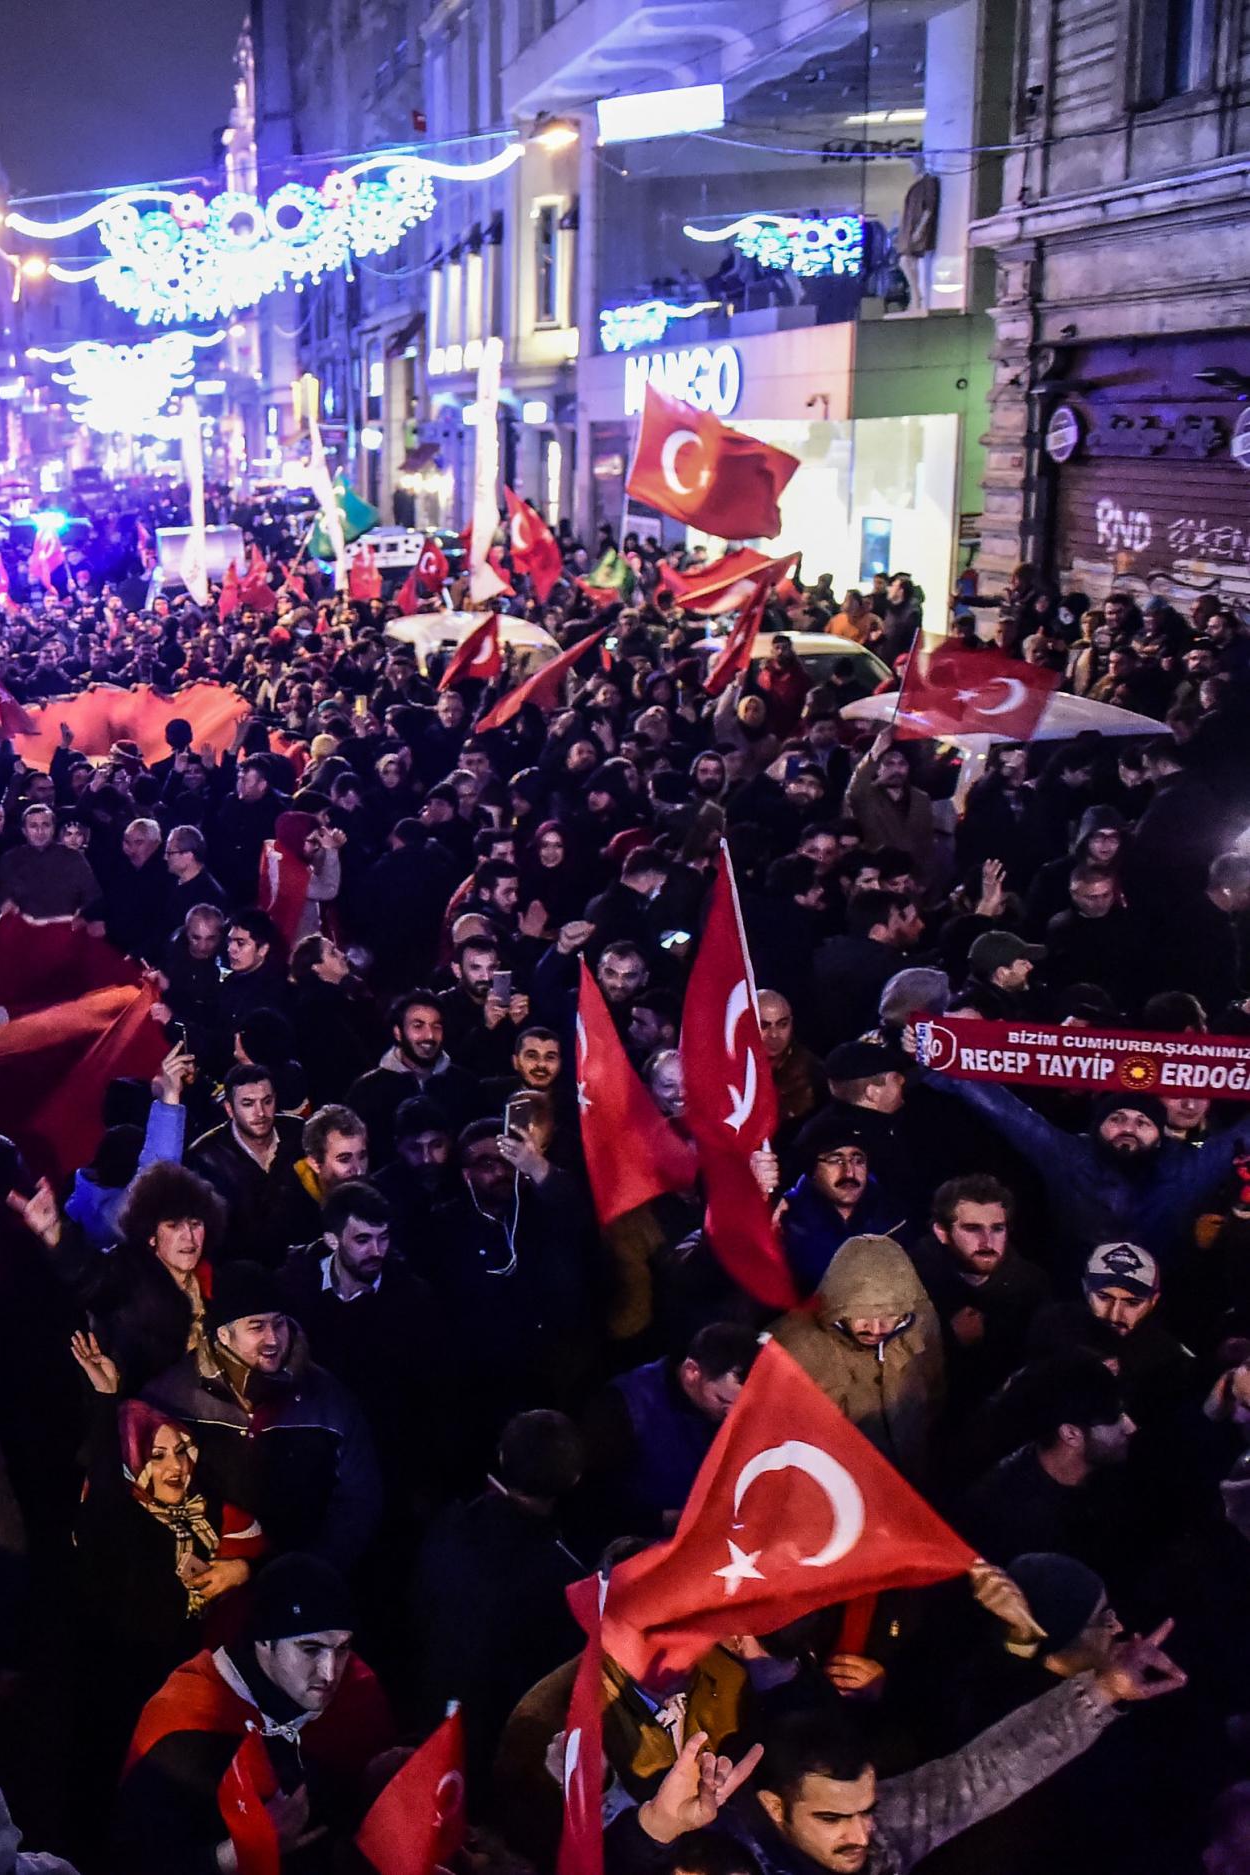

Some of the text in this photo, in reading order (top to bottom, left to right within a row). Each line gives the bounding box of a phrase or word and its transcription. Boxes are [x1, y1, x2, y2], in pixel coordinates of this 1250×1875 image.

[624, 345, 740, 415] MANGO
[1007, 1030, 1058, 1046] BİZİM
[959, 1048, 1250, 1090] RECEP TAYYİP ERDOĞ
